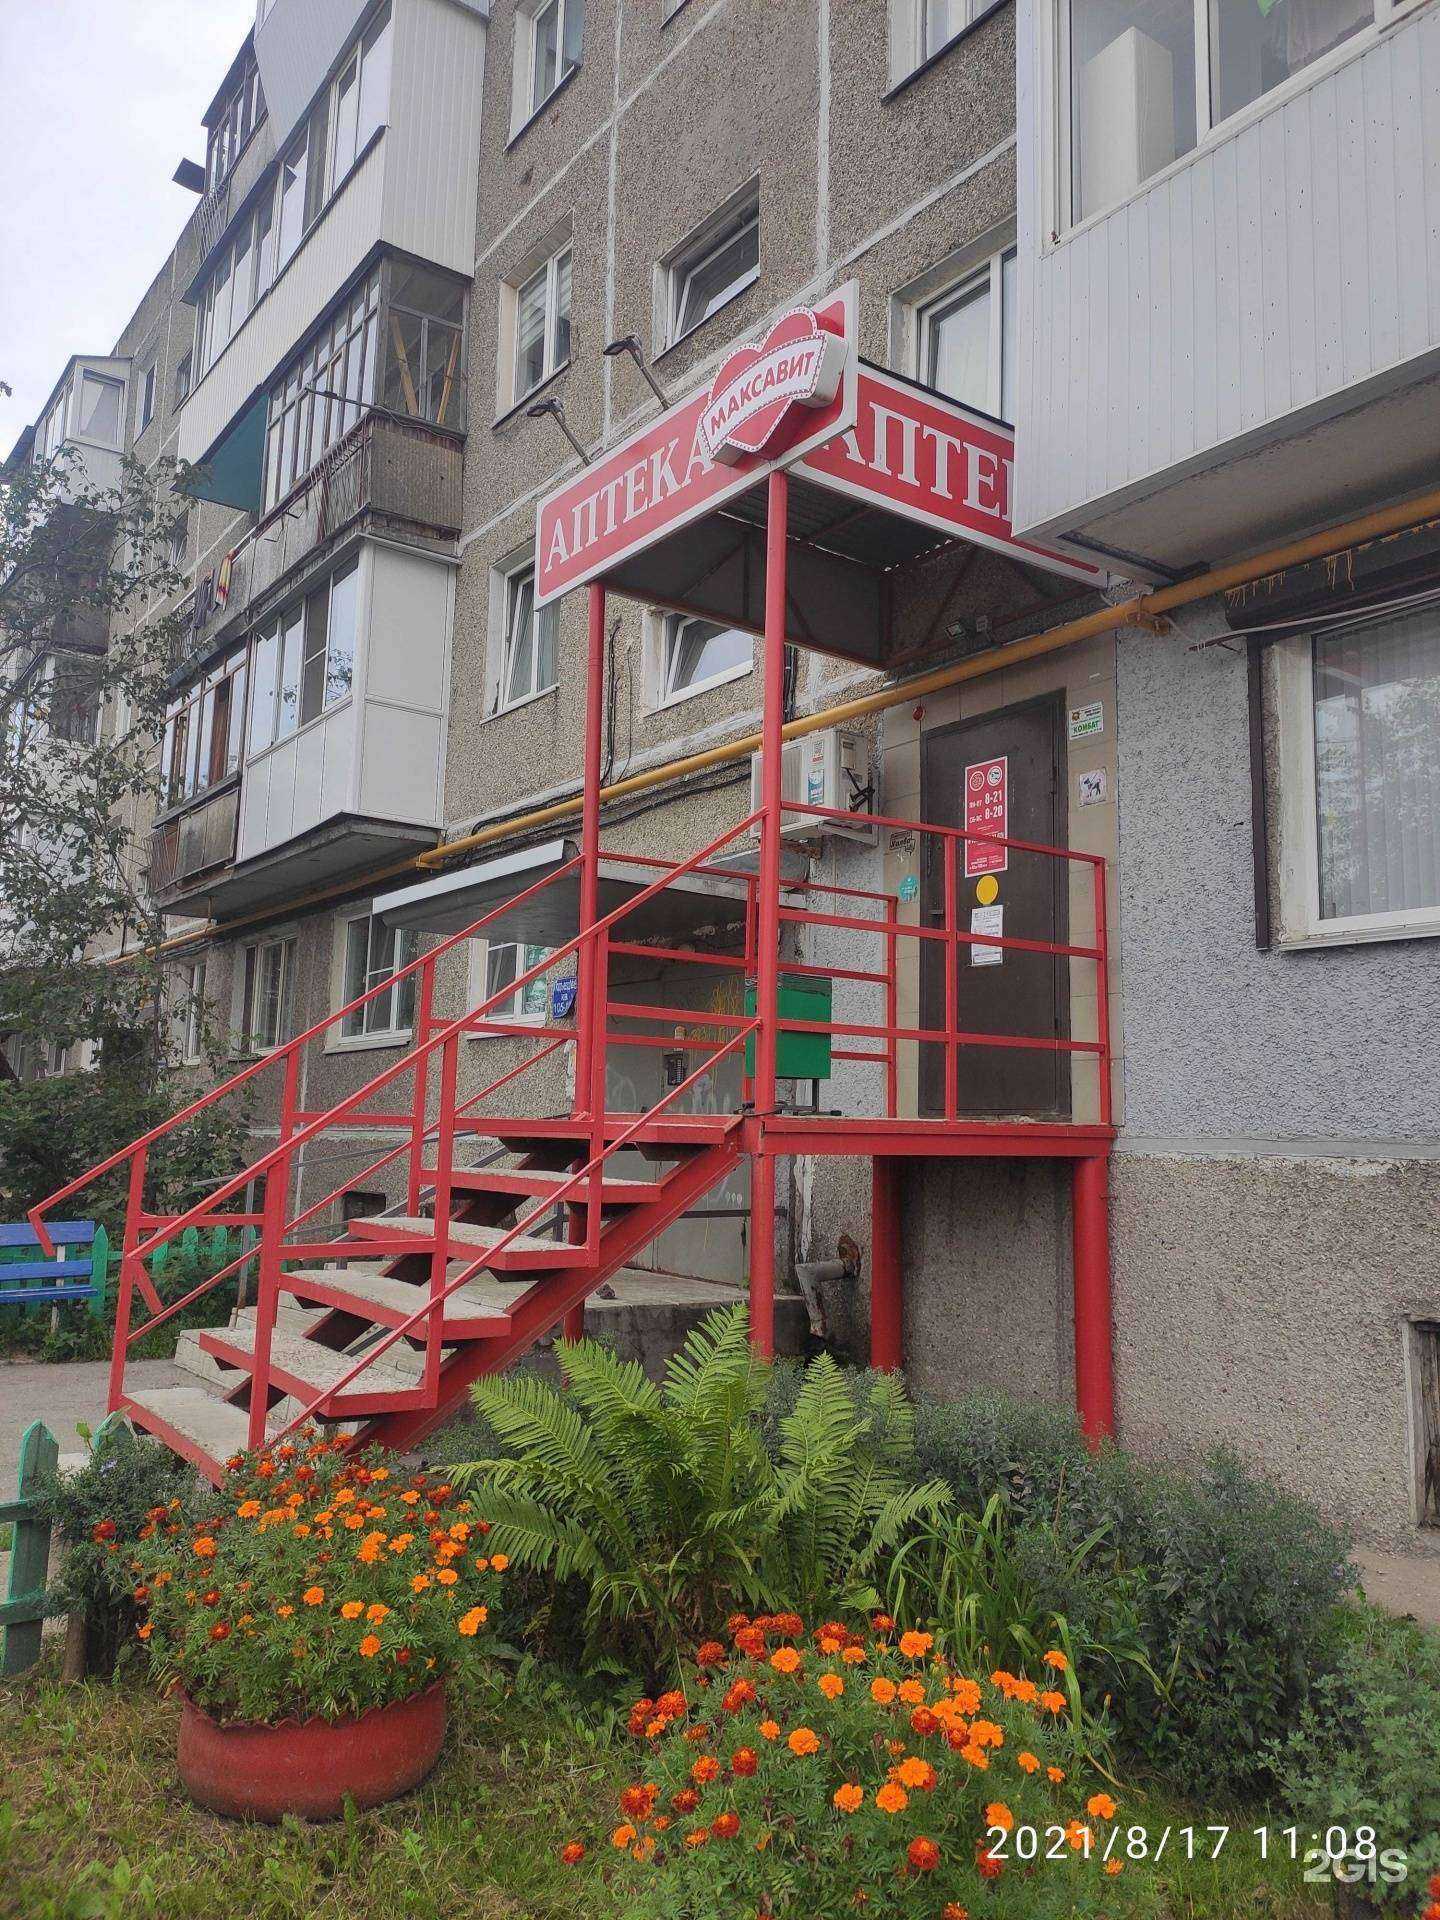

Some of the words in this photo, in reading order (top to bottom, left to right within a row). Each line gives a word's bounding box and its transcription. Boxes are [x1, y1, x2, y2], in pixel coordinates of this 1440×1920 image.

[709, 350, 816, 436] МАКСАВИТ
[544, 432, 717, 574] АПТЕКА
[984, 790, 1003, 805] 8-21
[984, 804, 1003, 820] 8-20
